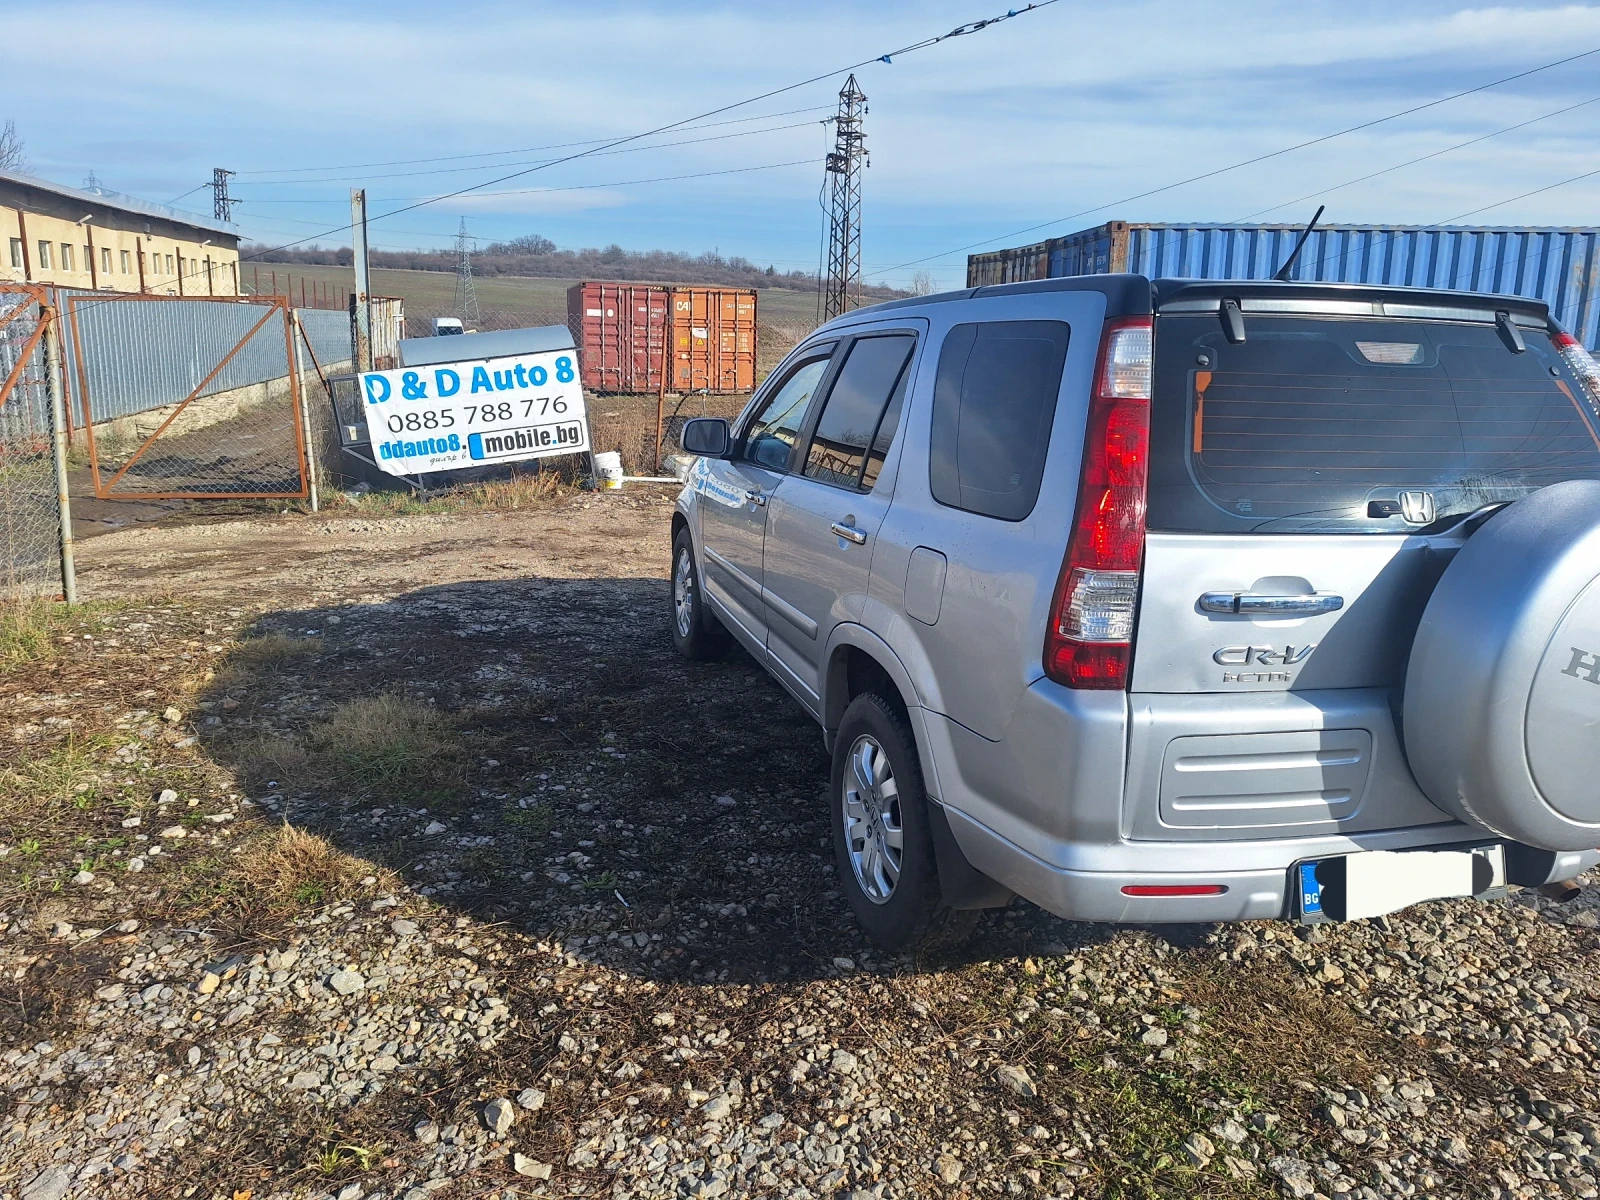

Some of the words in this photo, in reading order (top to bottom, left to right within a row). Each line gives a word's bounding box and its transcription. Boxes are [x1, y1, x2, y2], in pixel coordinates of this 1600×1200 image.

[364, 374, 391, 404] D
[402, 371, 428, 400] &
[435, 369, 460, 397] D
[471, 363, 548, 394] Auto
[555, 356, 574, 383] 8
[387, 408, 455, 433] 0885
[463, 402, 513, 424] 788
[520, 396, 567, 418] 776
[485, 426, 579, 453] mobile.bg
[1213, 643, 1318, 666] CR-V
[1304, 892, 1319, 905] BG
